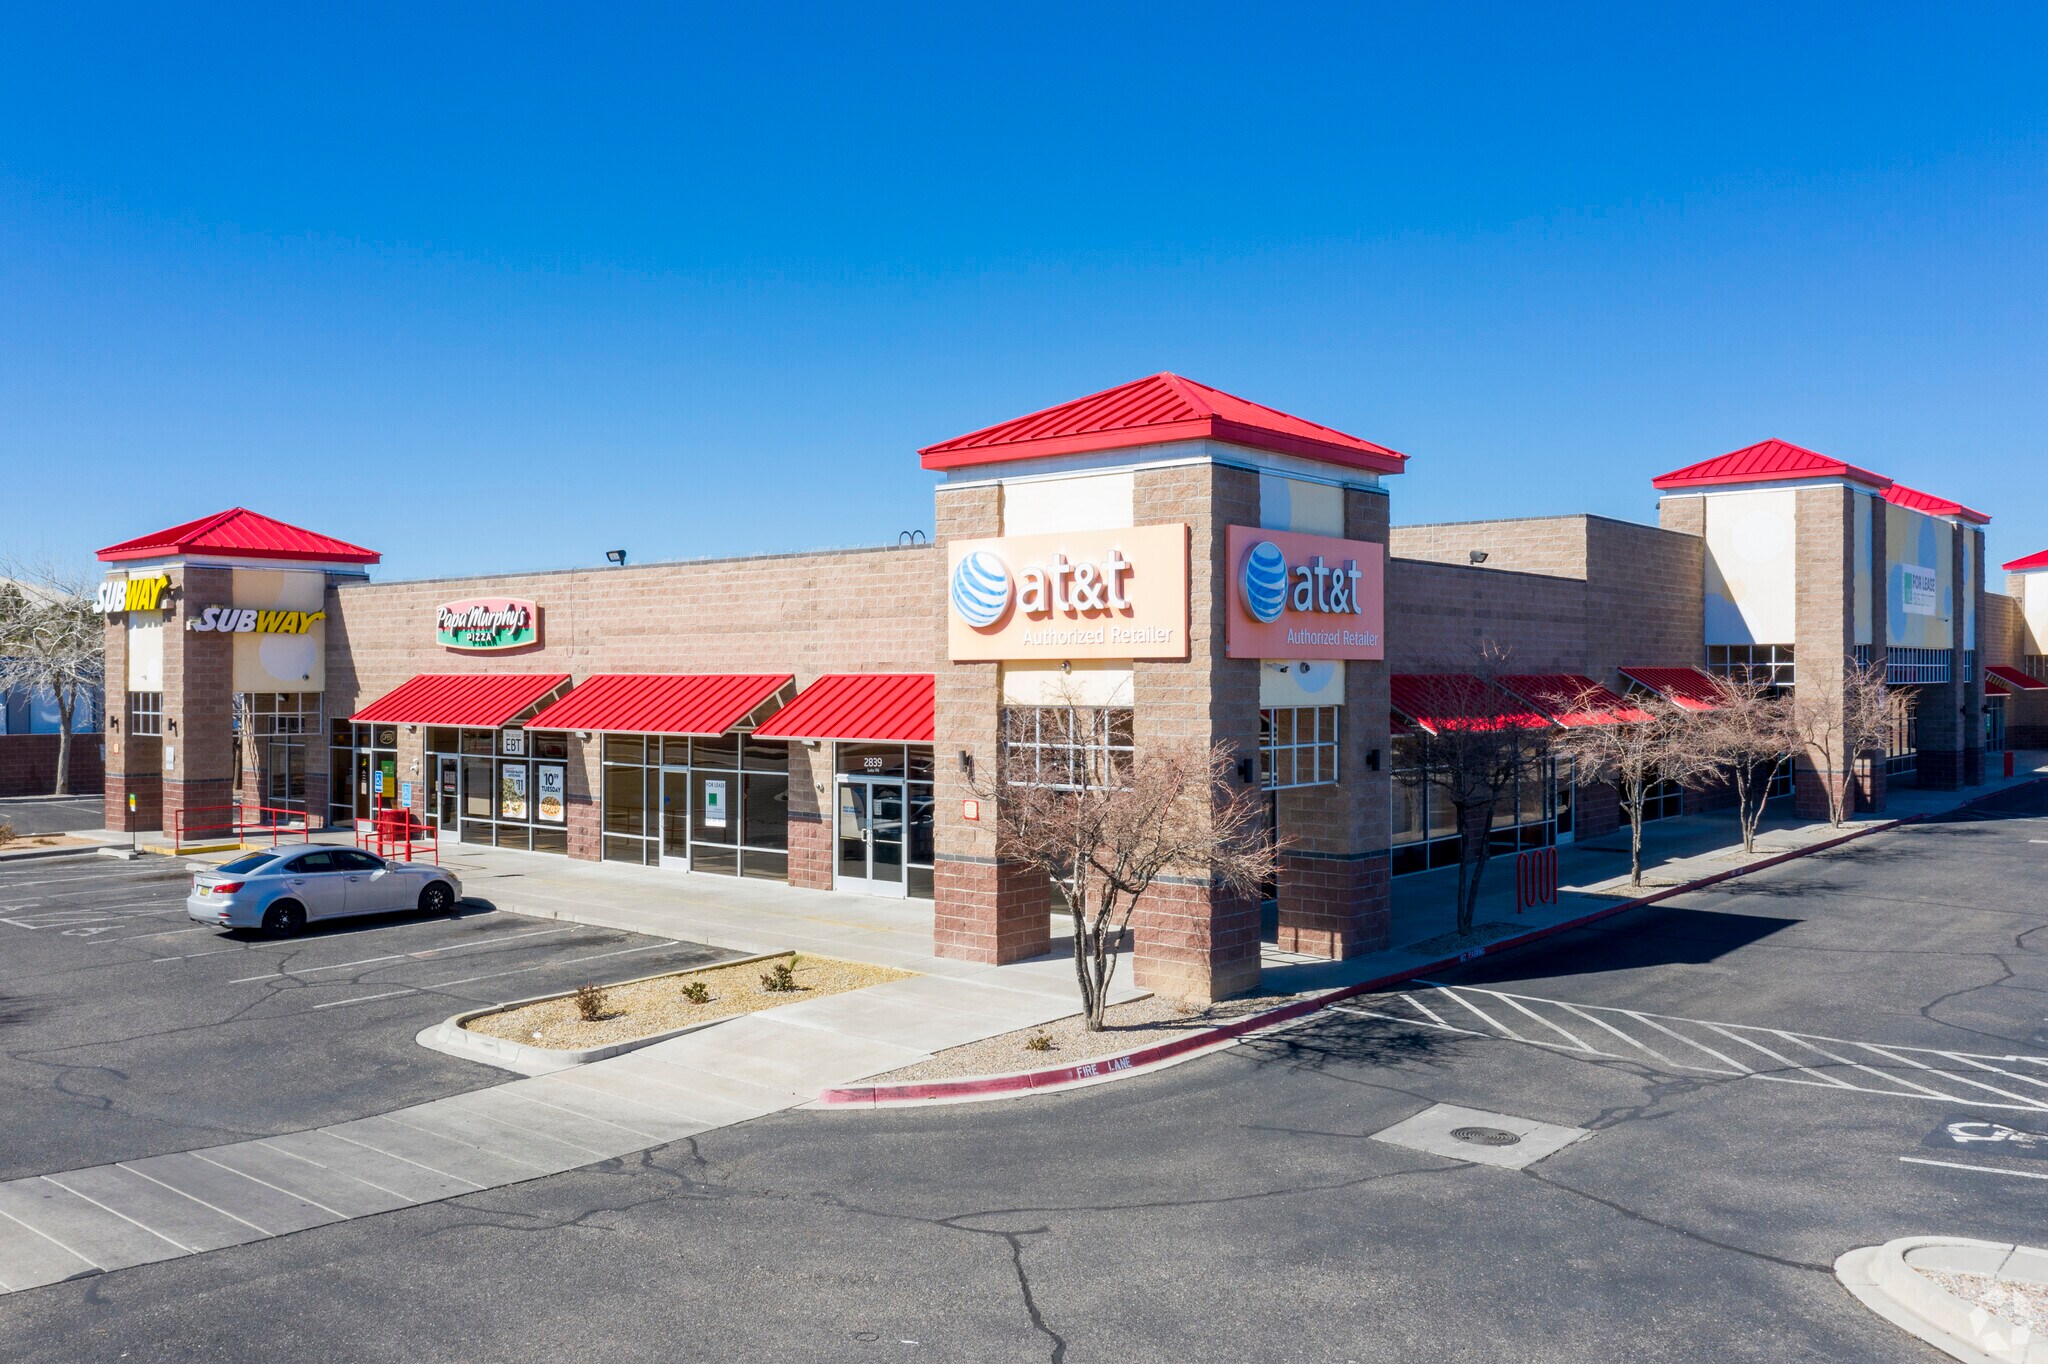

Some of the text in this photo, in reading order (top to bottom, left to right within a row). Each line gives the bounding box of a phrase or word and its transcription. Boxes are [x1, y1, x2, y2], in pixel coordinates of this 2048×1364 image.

[1016, 550, 1131, 613] at&t
[1293, 556, 1363, 615] at&t
[93, 575, 168, 613] SUBWAY
[194, 608, 327, 635] SUBWAY
[438, 604, 525, 637] Papa Murphy's
[466, 632, 492, 642] PIZZA
[1023, 625, 1173, 645] Authorized Retailer
[1287, 628, 1379, 647] Authorized Retailer
[506, 738, 522, 752] EBT
[863, 757, 883, 768] 2839
[541, 785, 562, 793] TUESDAY
[1076, 1057, 1133, 1080] FIRE LANE
